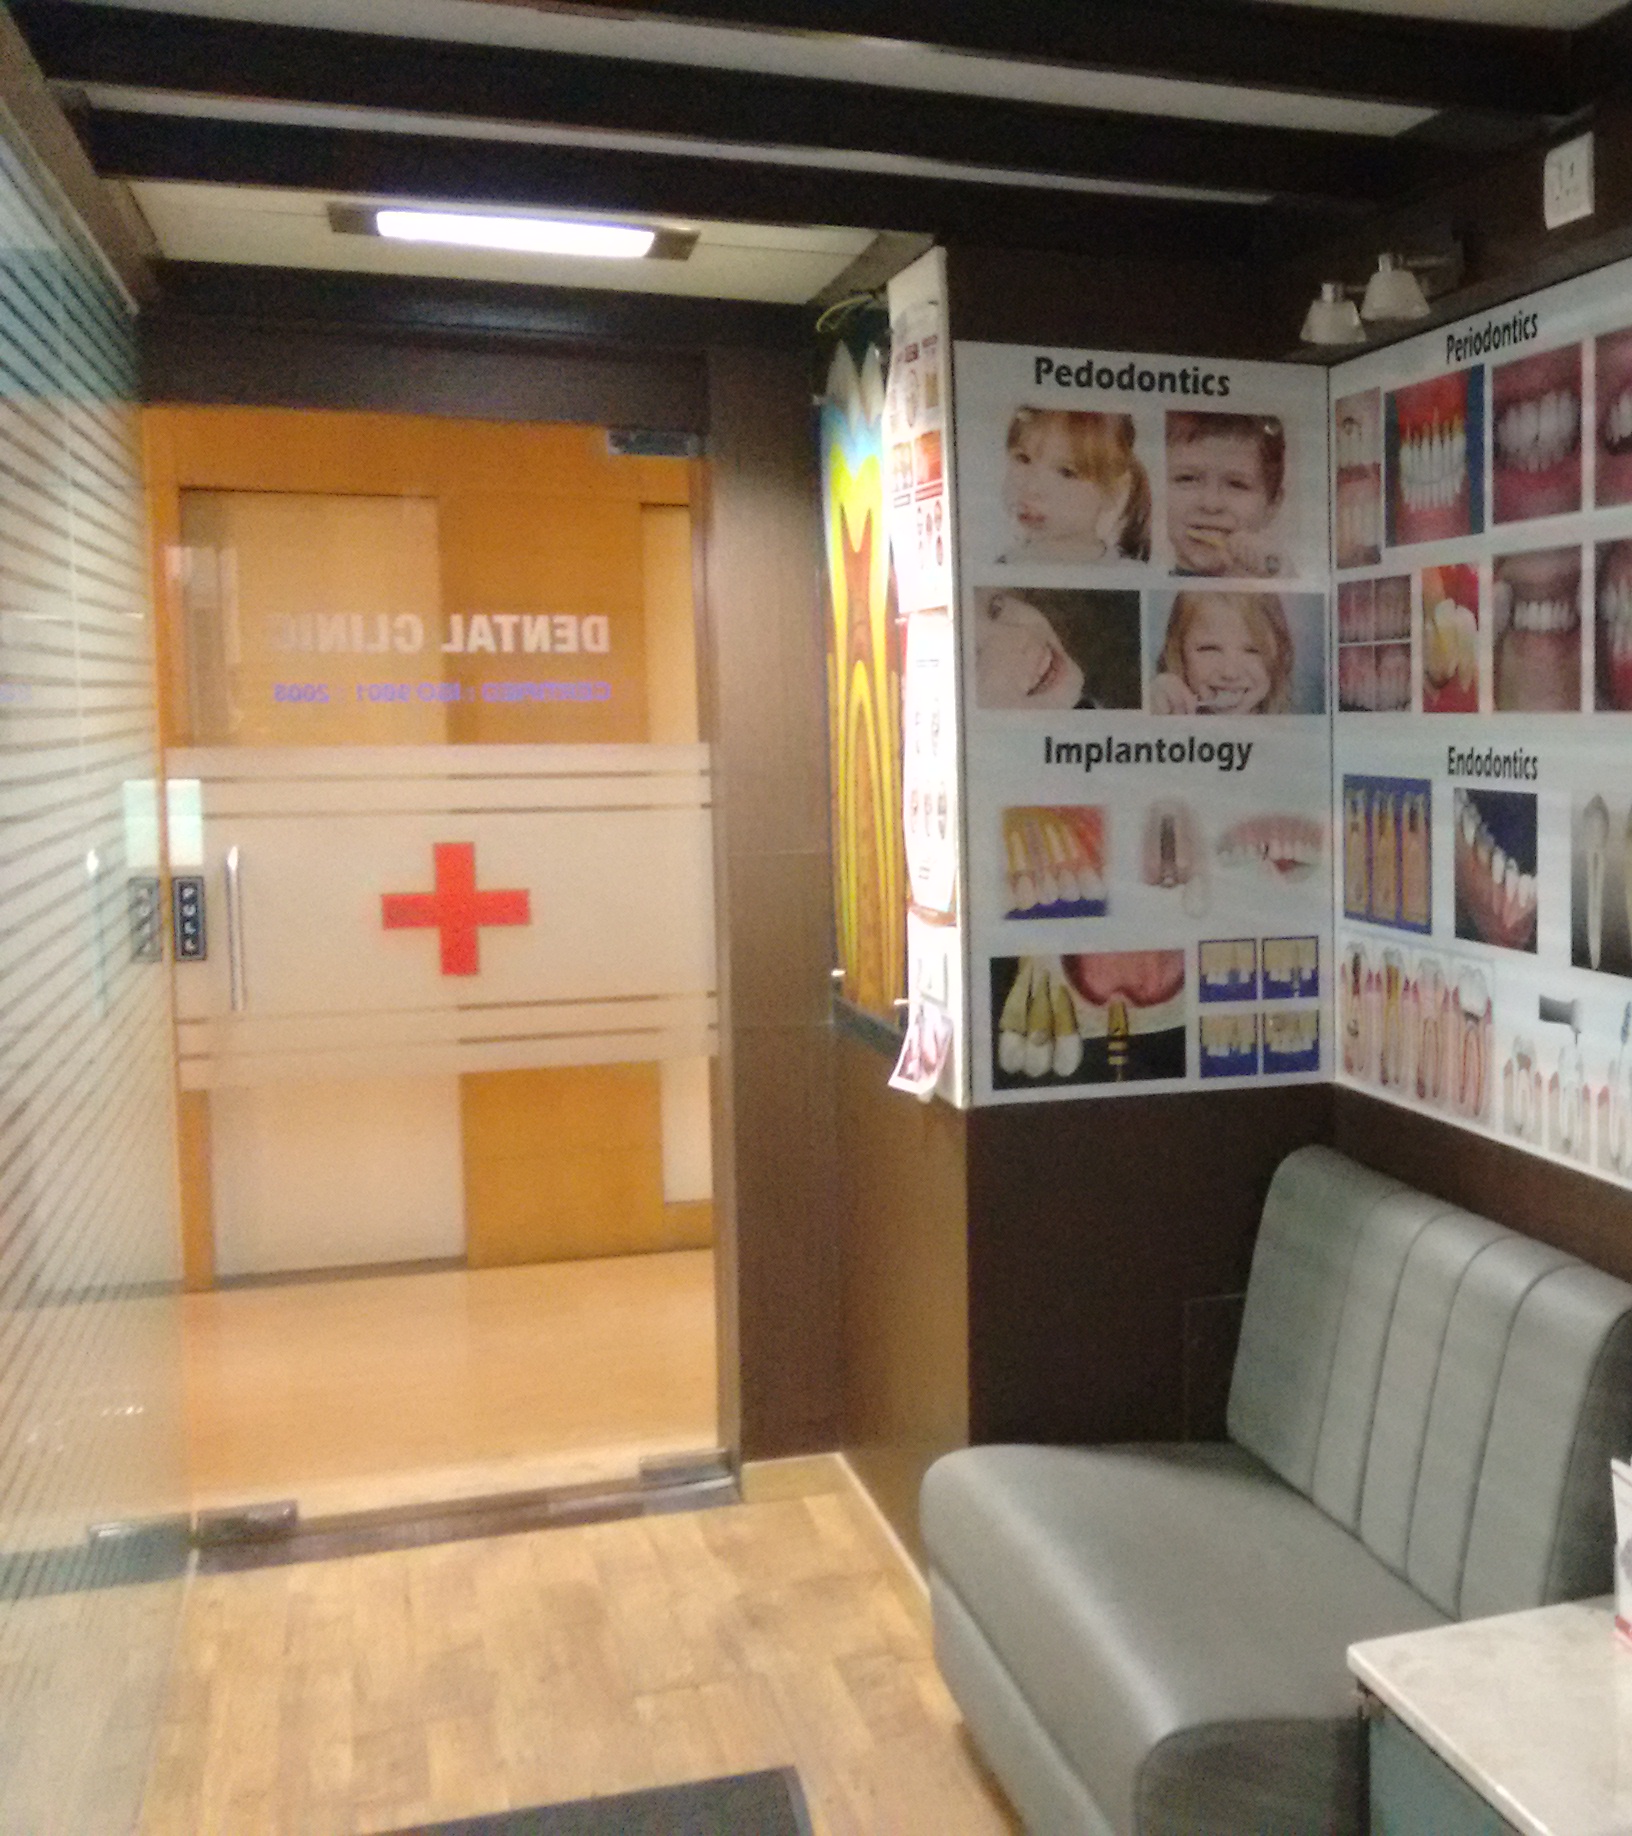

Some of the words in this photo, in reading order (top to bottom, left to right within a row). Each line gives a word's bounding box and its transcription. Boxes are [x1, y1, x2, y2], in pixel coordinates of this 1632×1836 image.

[1445, 311, 1538, 364] Periodontics
[1034, 356, 1231, 397] Pedodontics
[1043, 736, 1253, 772] Implantology
[1447, 745, 1538, 781] Endodontics
